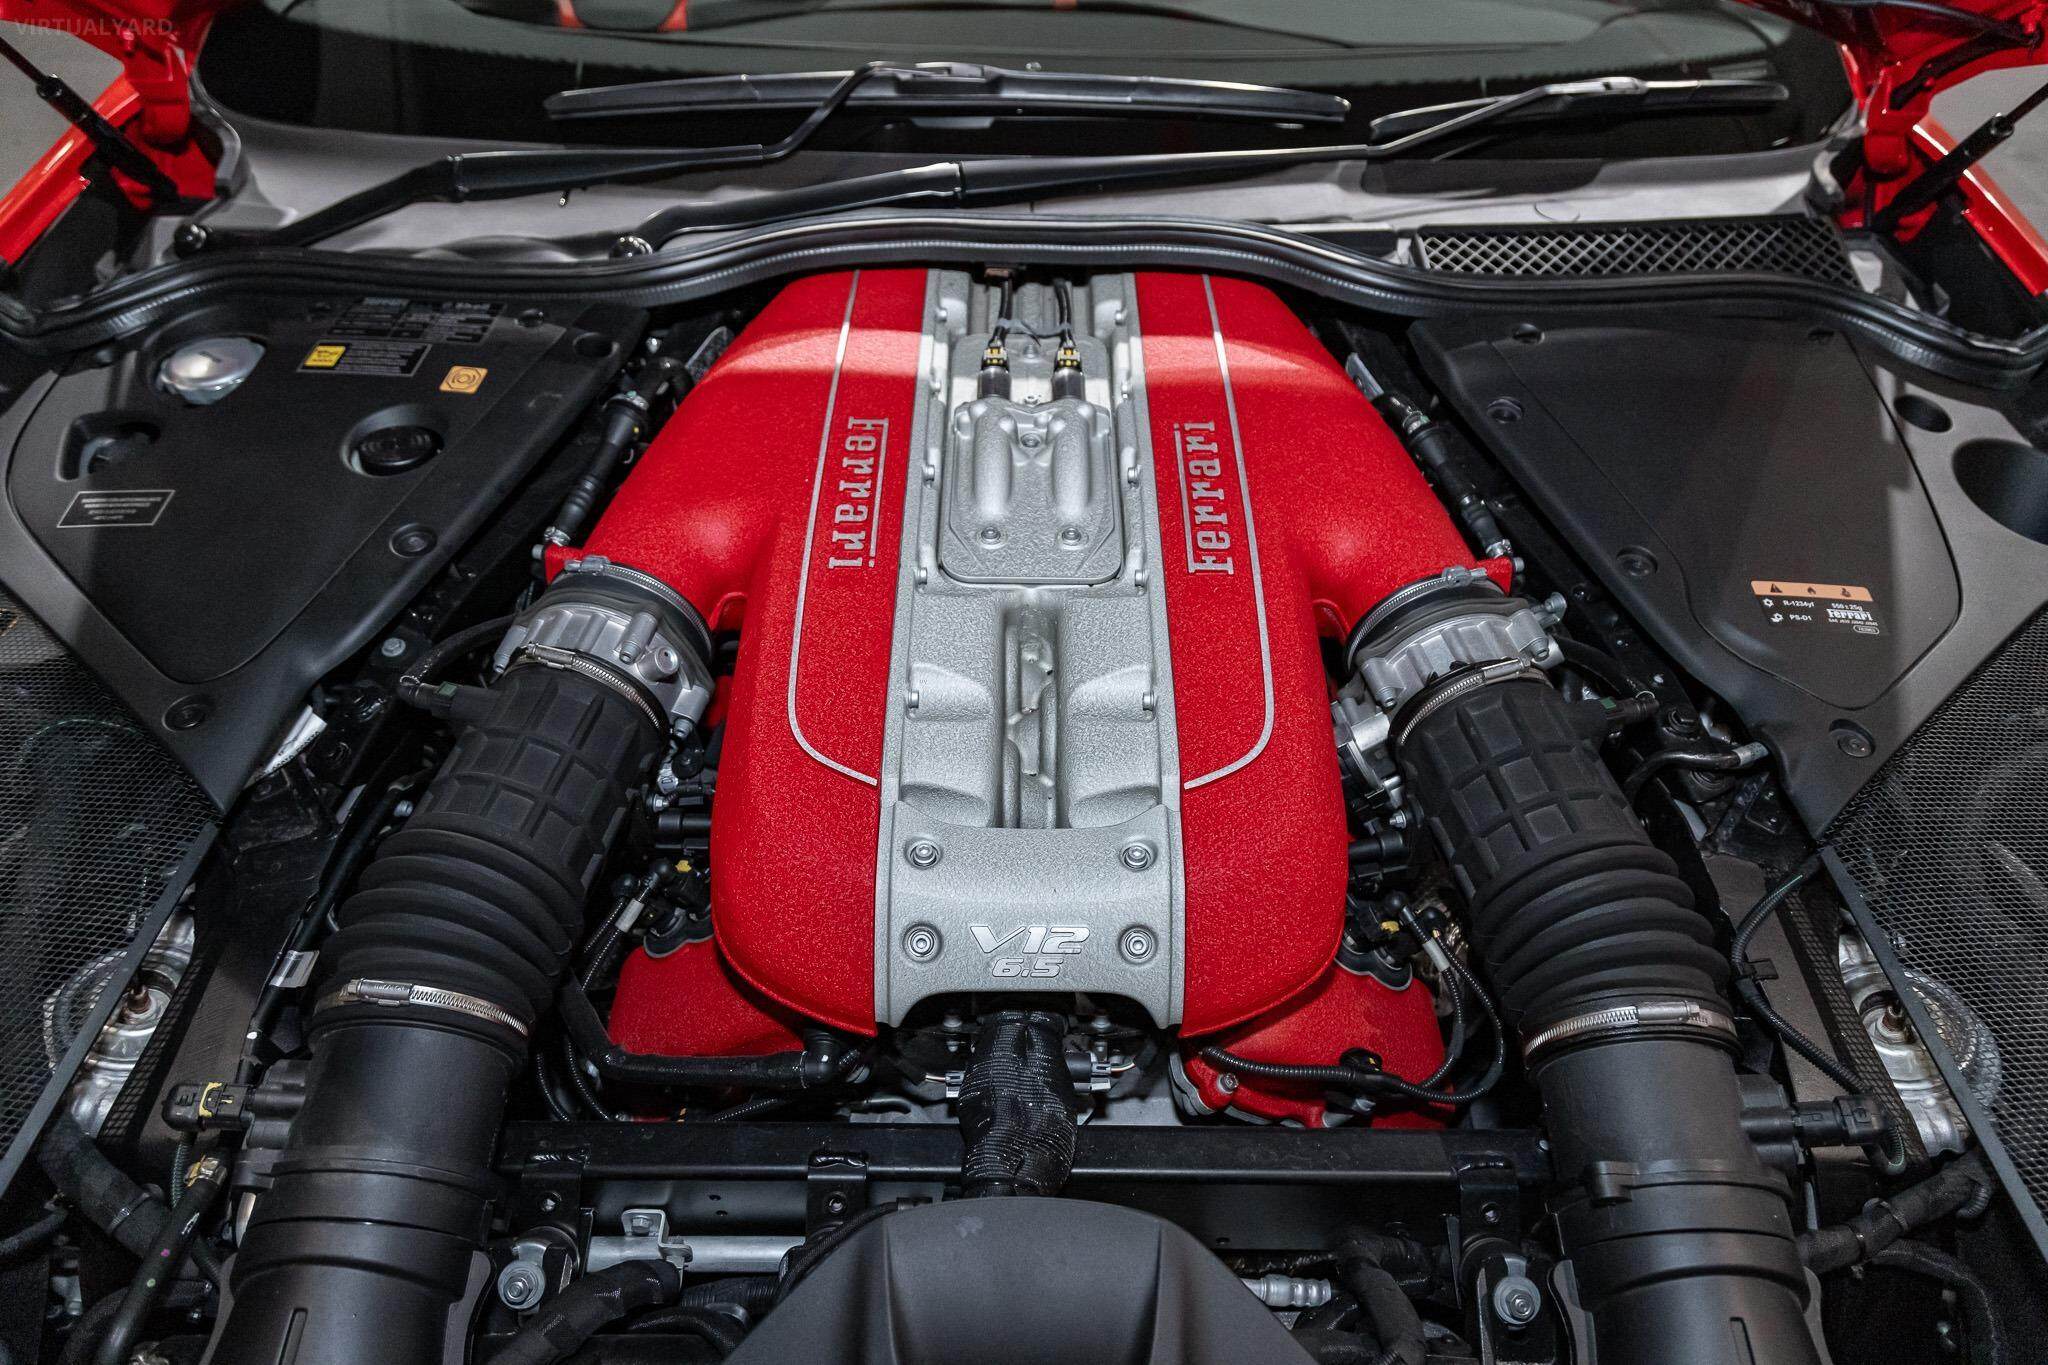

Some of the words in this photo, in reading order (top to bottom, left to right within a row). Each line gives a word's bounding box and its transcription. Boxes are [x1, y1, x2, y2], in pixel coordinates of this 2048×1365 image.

[827, 416, 889, 570] Ferrari
[1173, 420, 1234, 576] Ferrari
[1826, 608, 1873, 621] Ferrari
[970, 926, 1090, 954] V12
[992, 957, 1064, 978] 6.5
